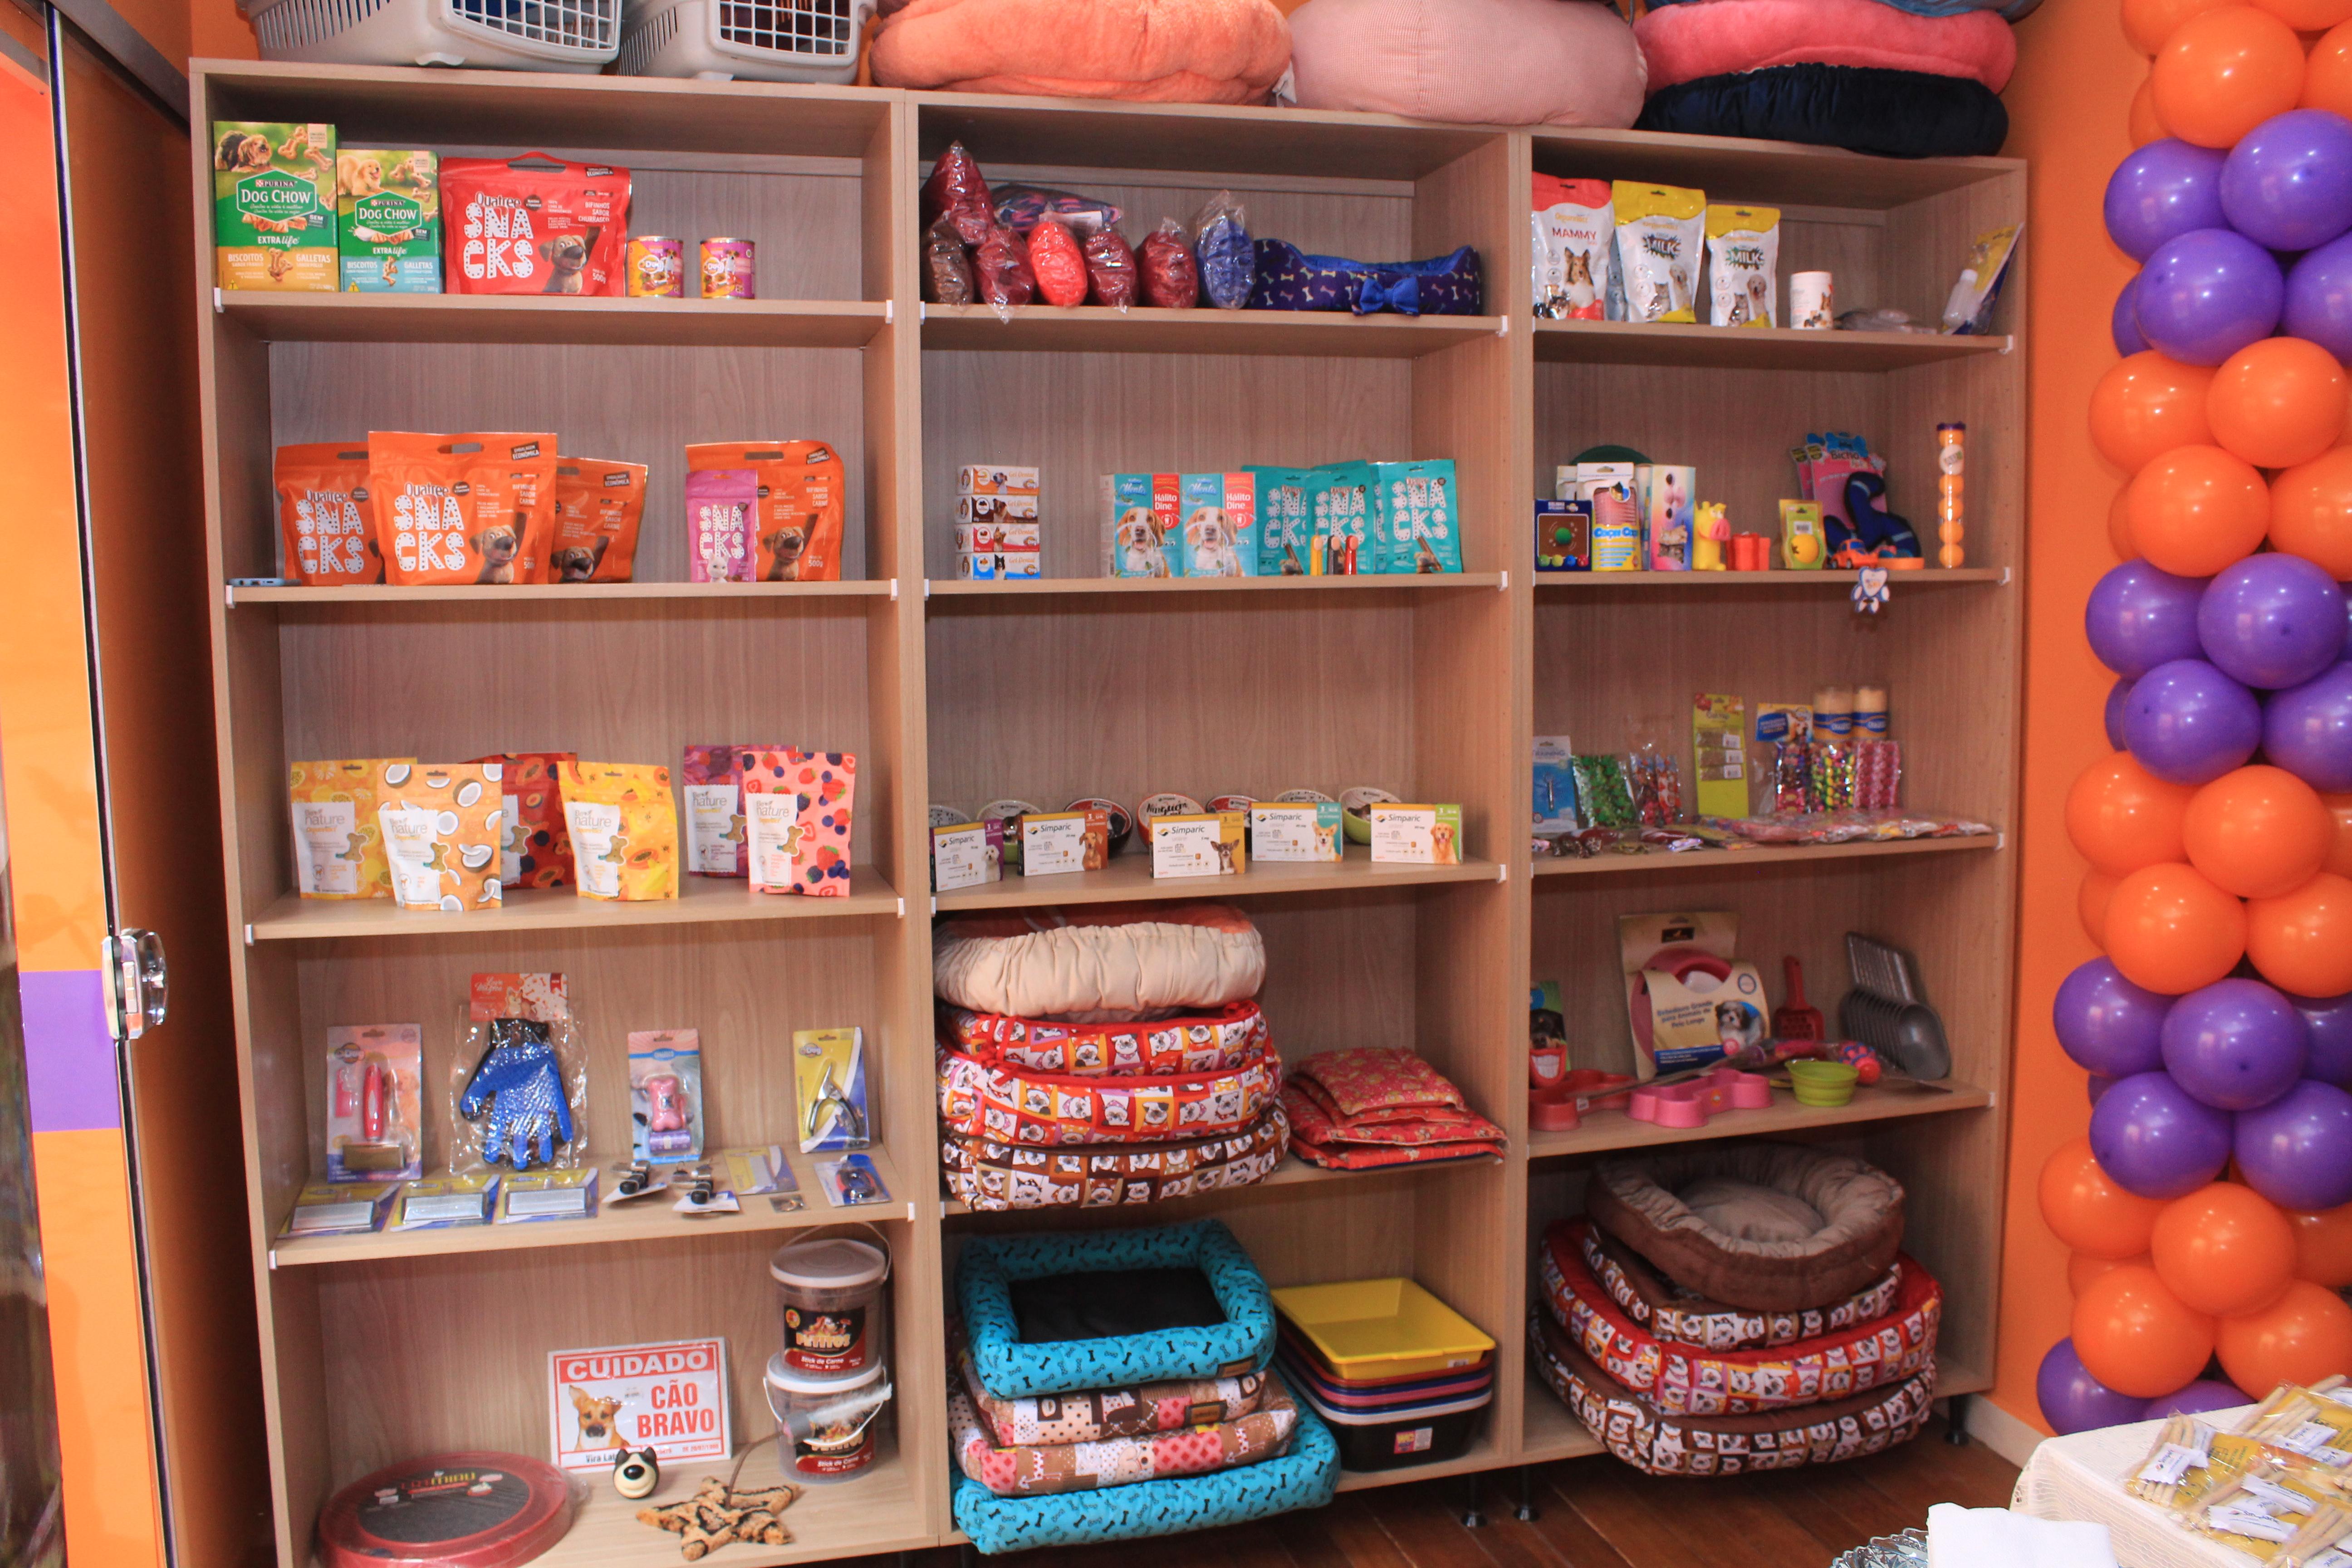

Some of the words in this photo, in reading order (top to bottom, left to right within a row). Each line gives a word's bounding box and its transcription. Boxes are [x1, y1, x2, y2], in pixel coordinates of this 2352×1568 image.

[241, 189, 268, 203] DOG
[271, 189, 311, 203] CHOW
[475, 191, 521, 208] Quatree
[359, 208, 382, 220] DOG
[384, 208, 417, 220] CHOW
[592, 208, 610, 216] SABOR
[464, 202, 534, 239] SNA
[1553, 227, 1597, 240] MAMMY
[258, 236, 281, 245] EXTRA
[281, 235, 299, 247] life
[1647, 238, 1678, 255] MILK
[228, 254, 264, 262] BISCOITOS
[392, 246, 407, 257] life
[1730, 250, 1762, 265] MILK
[296, 254, 331, 263] GALLETAS
[464, 239, 534, 279] CKS
[405, 482, 449, 496] Quatree
[1392, 478, 1446, 509] SNA
[305, 489, 348, 503] Quatree
[296, 500, 363, 534] SNA
[394, 495, 465, 531] SNA
[699, 505, 745, 531] SNA
[1394, 508, 1448, 541] CKS
[298, 535, 364, 574] CKS
[395, 531, 466, 572] CKS
[693, 797, 727, 806] nature
[756, 806, 789, 817] nature
[1269, 813, 1302, 822] Simparic
[305, 815, 345, 825] nature
[575, 816, 612, 827] nature
[1388, 814, 1421, 823] Simparic
[392, 823, 427, 834] nature
[1040, 823, 1071, 833] Simparic
[1171, 825, 1205, 835] Simparic
[949, 835, 975, 846] Simparic
[1691, 1001, 1714, 1010] Grande
[567, 1350, 709, 1381] CUIDADO
[651, 1378, 699, 1409] CÃO
[637, 1408, 715, 1439] BRAVO
[586, 1453, 602, 1464] Vira
